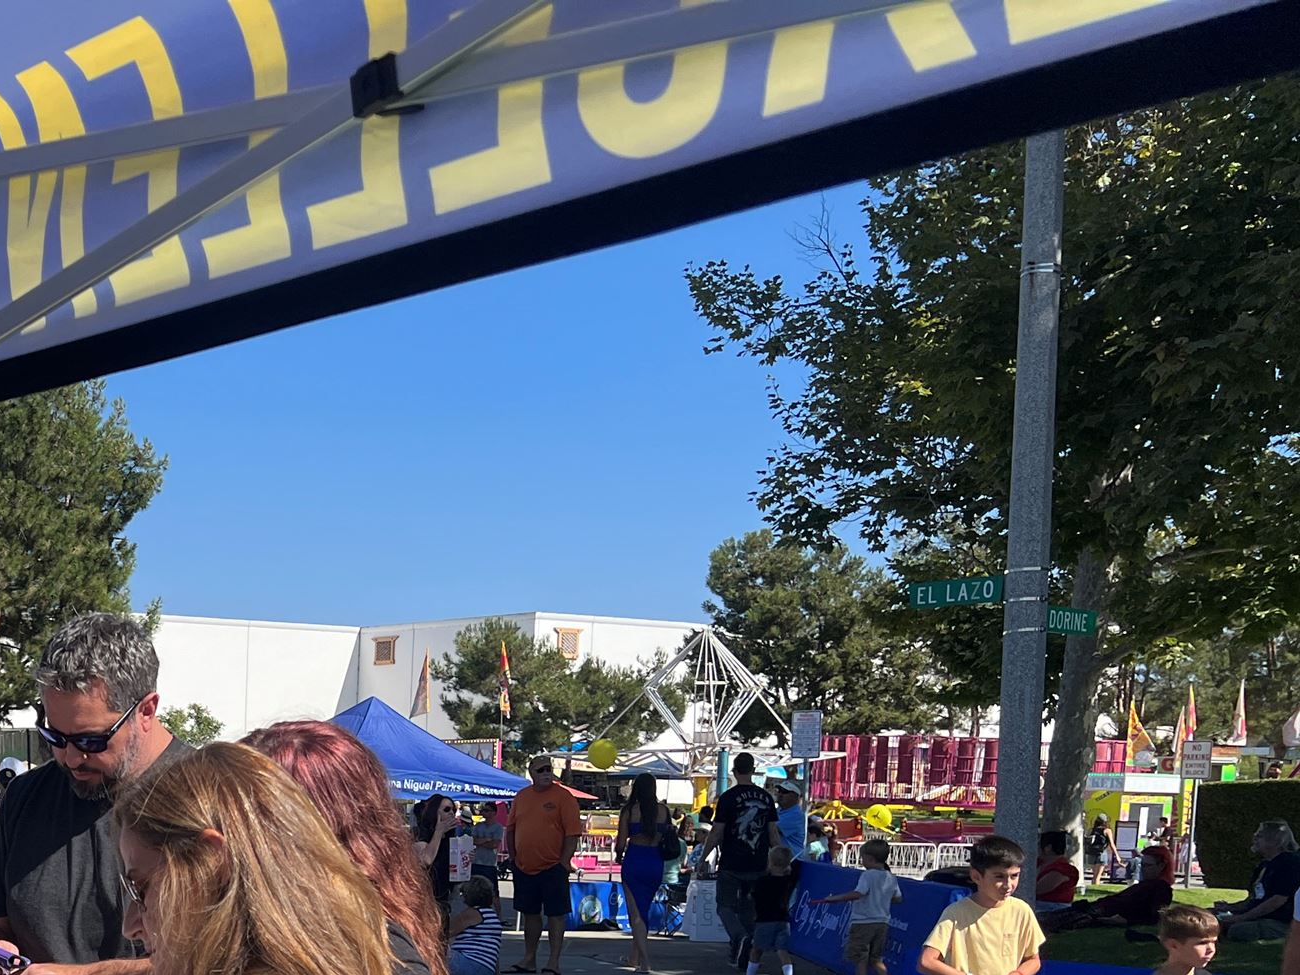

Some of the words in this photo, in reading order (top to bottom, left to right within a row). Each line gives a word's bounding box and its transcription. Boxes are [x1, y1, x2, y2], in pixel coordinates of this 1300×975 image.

[917, 586, 937, 605] EL
[946, 580, 994, 603] LAZO
[1049, 609, 1088, 633] DORINE
[1191, 744, 1203, 752] NO
[1183, 753, 1211, 761] PARKING
[403, 779, 433, 792] Niguel
[434, 781, 462, 793] Parks
[464, 783, 472, 792] &
